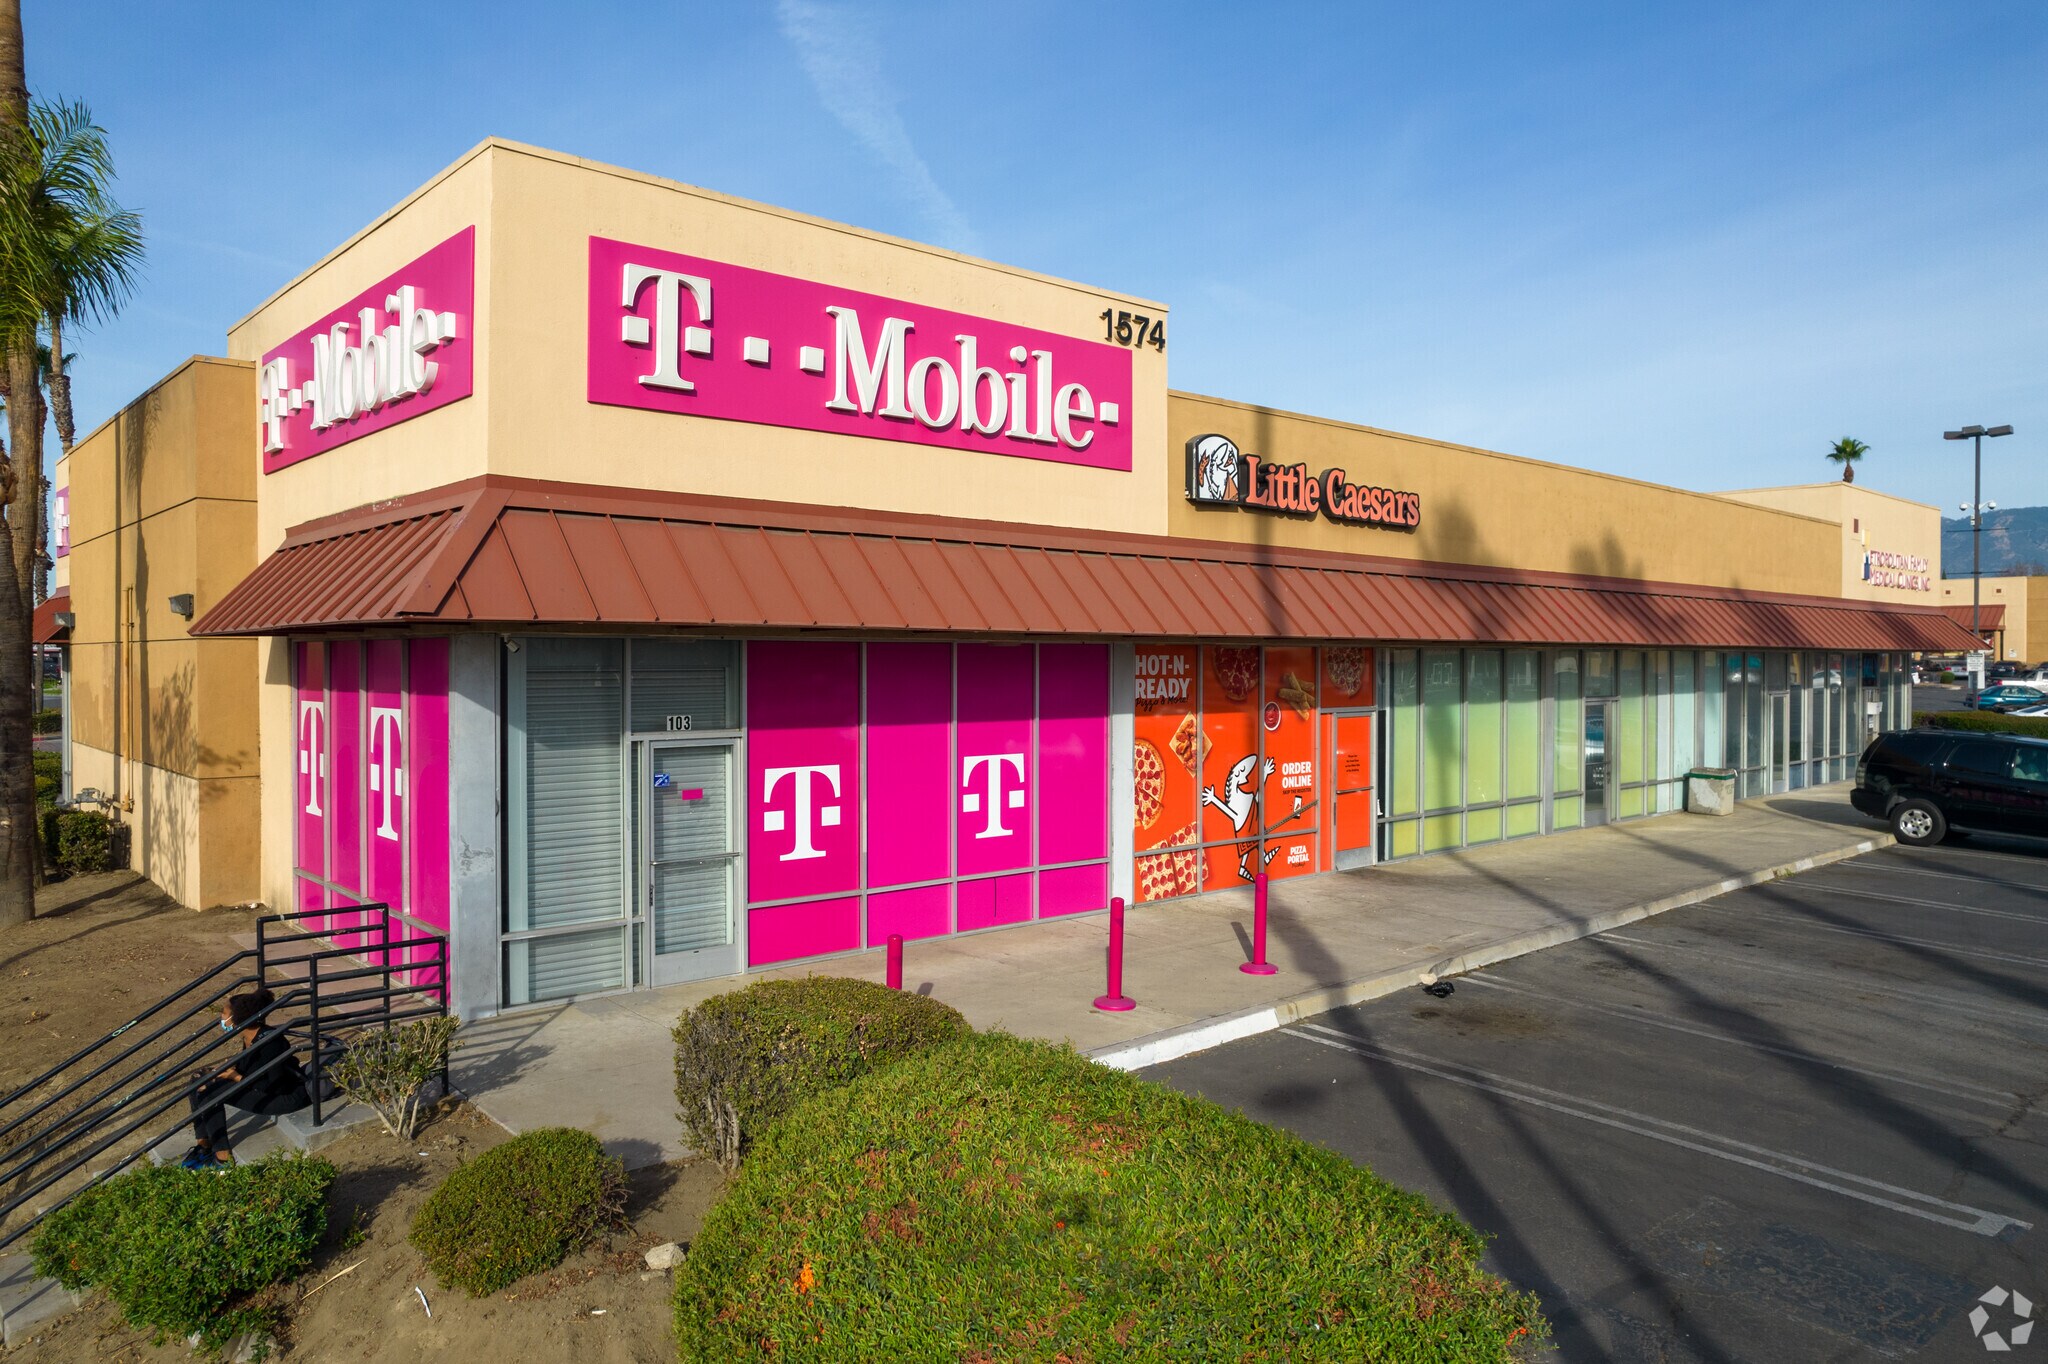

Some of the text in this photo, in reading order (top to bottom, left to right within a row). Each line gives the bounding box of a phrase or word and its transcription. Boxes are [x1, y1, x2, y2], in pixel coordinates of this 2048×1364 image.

[1102, 308, 1166, 352] 1574
[1244, 454, 1420, 527] Little Caesars
[1135, 655, 1190, 676] HOT-N-
[1135, 678, 1190, 699] READY
[668, 715, 691, 731] 103
[1281, 761, 1312, 776] ORDER
[1281, 774, 1312, 789] ONLINE
[962, 753, 1025, 840] T
[763, 764, 841, 862] T
[1287, 854, 1310, 864] PORTAL
[1290, 845, 1307, 855] PIZZA
